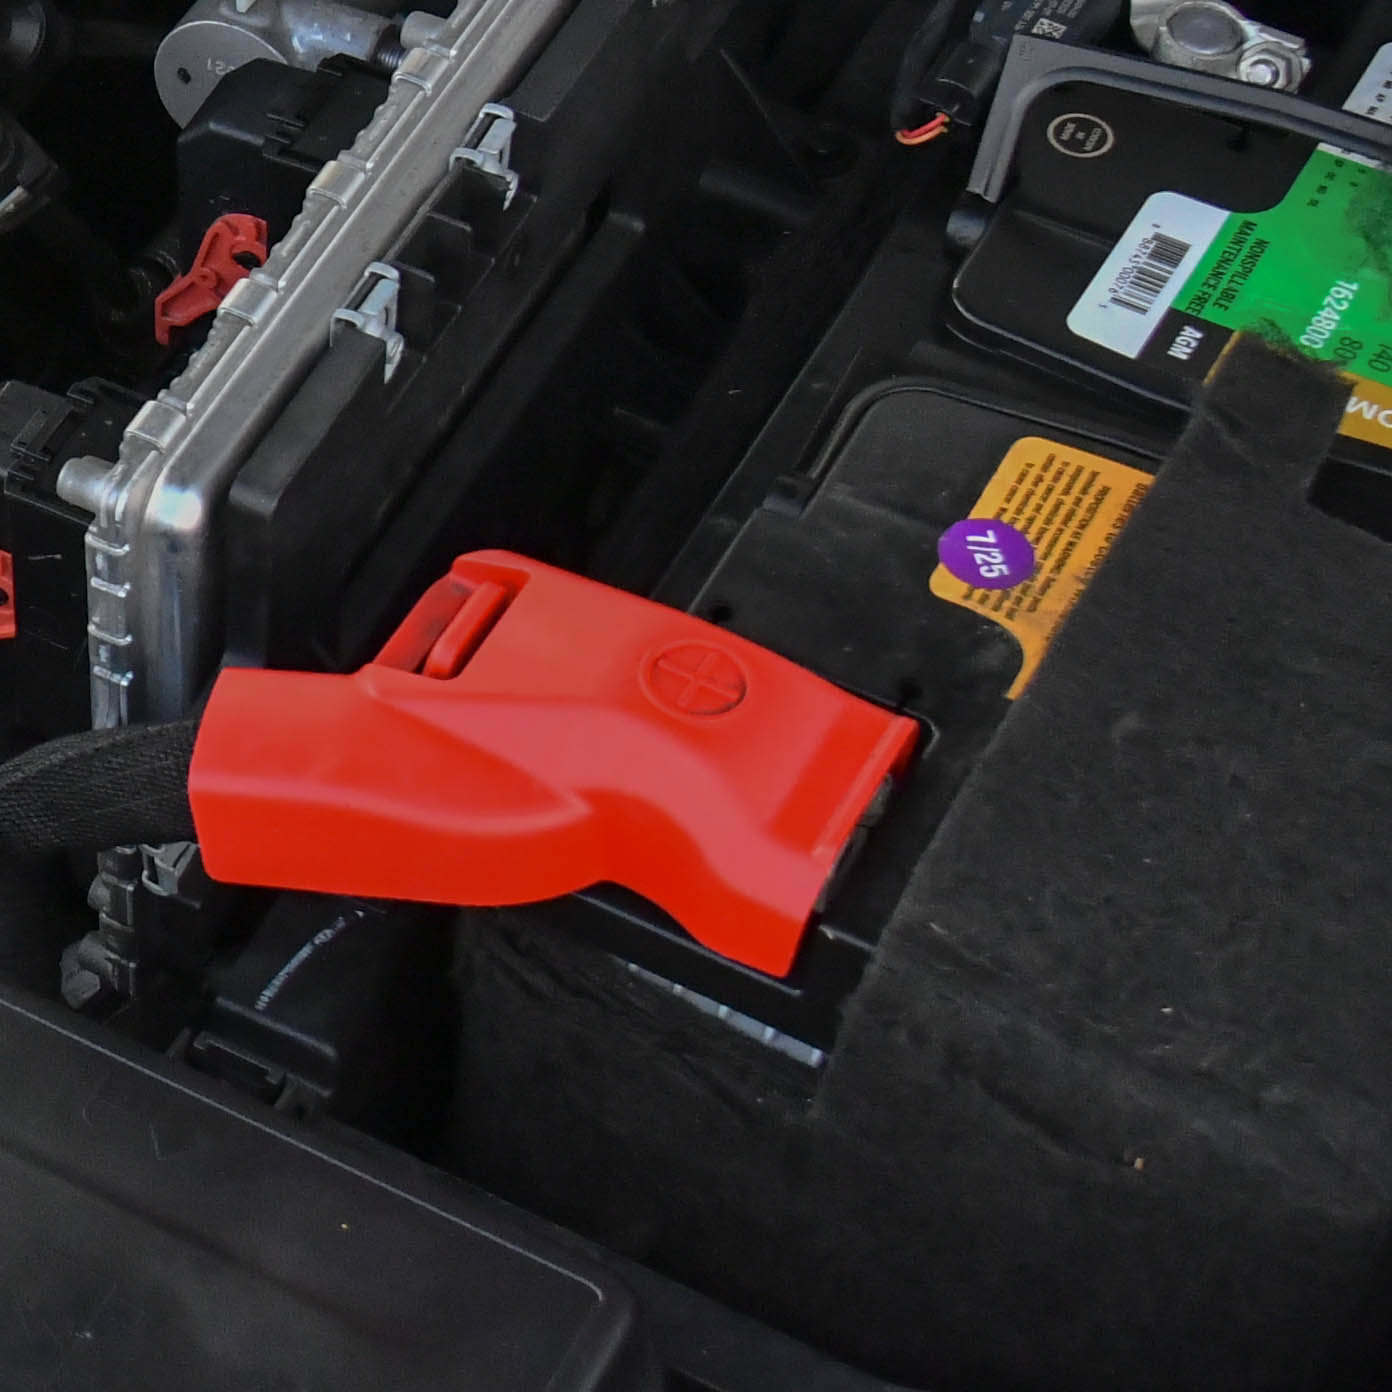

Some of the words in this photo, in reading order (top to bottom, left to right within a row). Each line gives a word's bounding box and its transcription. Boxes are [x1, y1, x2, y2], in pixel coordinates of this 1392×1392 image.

[1202, 220, 1257, 290] MAINTENANCE
[1213, 238, 1270, 312] NONSPILLABLE
[1185, 291, 1211, 316] FREE
[1299, 280, 1359, 349] 1624800
[1167, 325, 1204, 360] AGM
